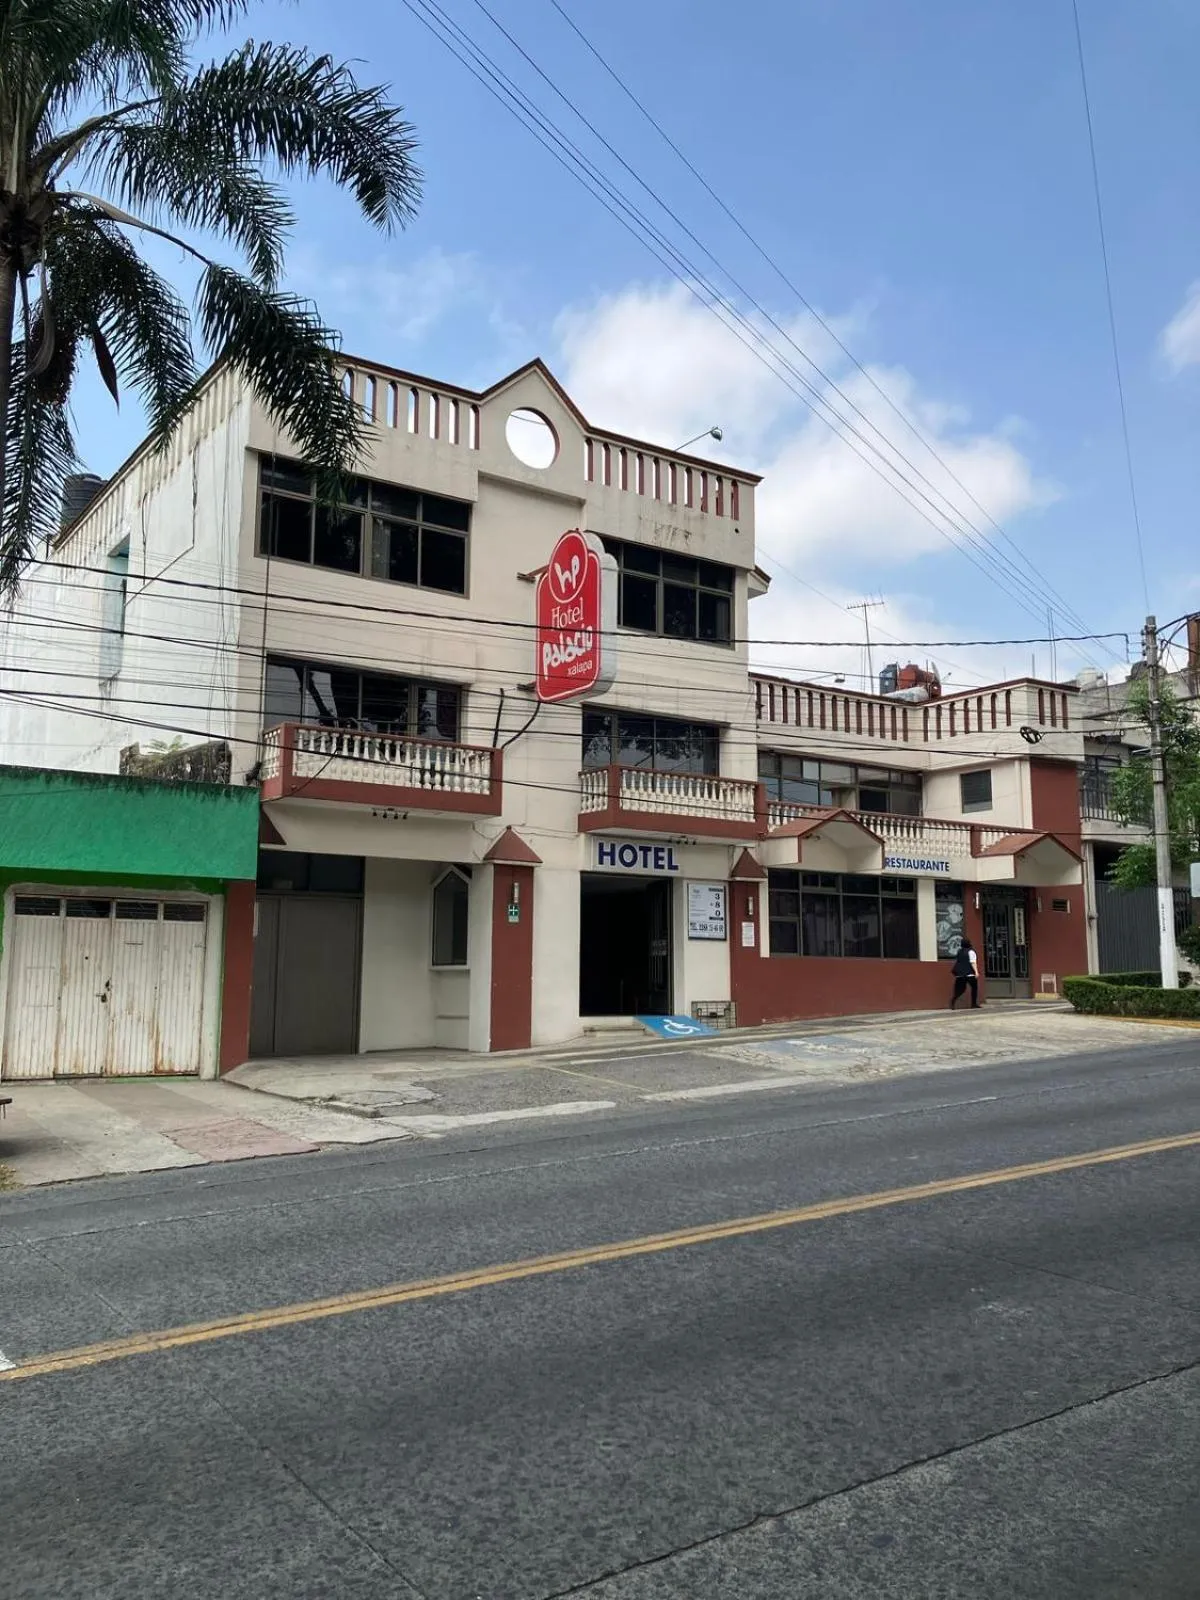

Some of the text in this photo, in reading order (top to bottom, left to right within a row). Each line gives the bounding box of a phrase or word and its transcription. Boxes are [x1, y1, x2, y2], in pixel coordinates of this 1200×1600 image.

[551, 597, 584, 631] Hotel
[598, 842, 679, 870] HOTEL
[884, 857, 950, 872] RESTAURANTE
